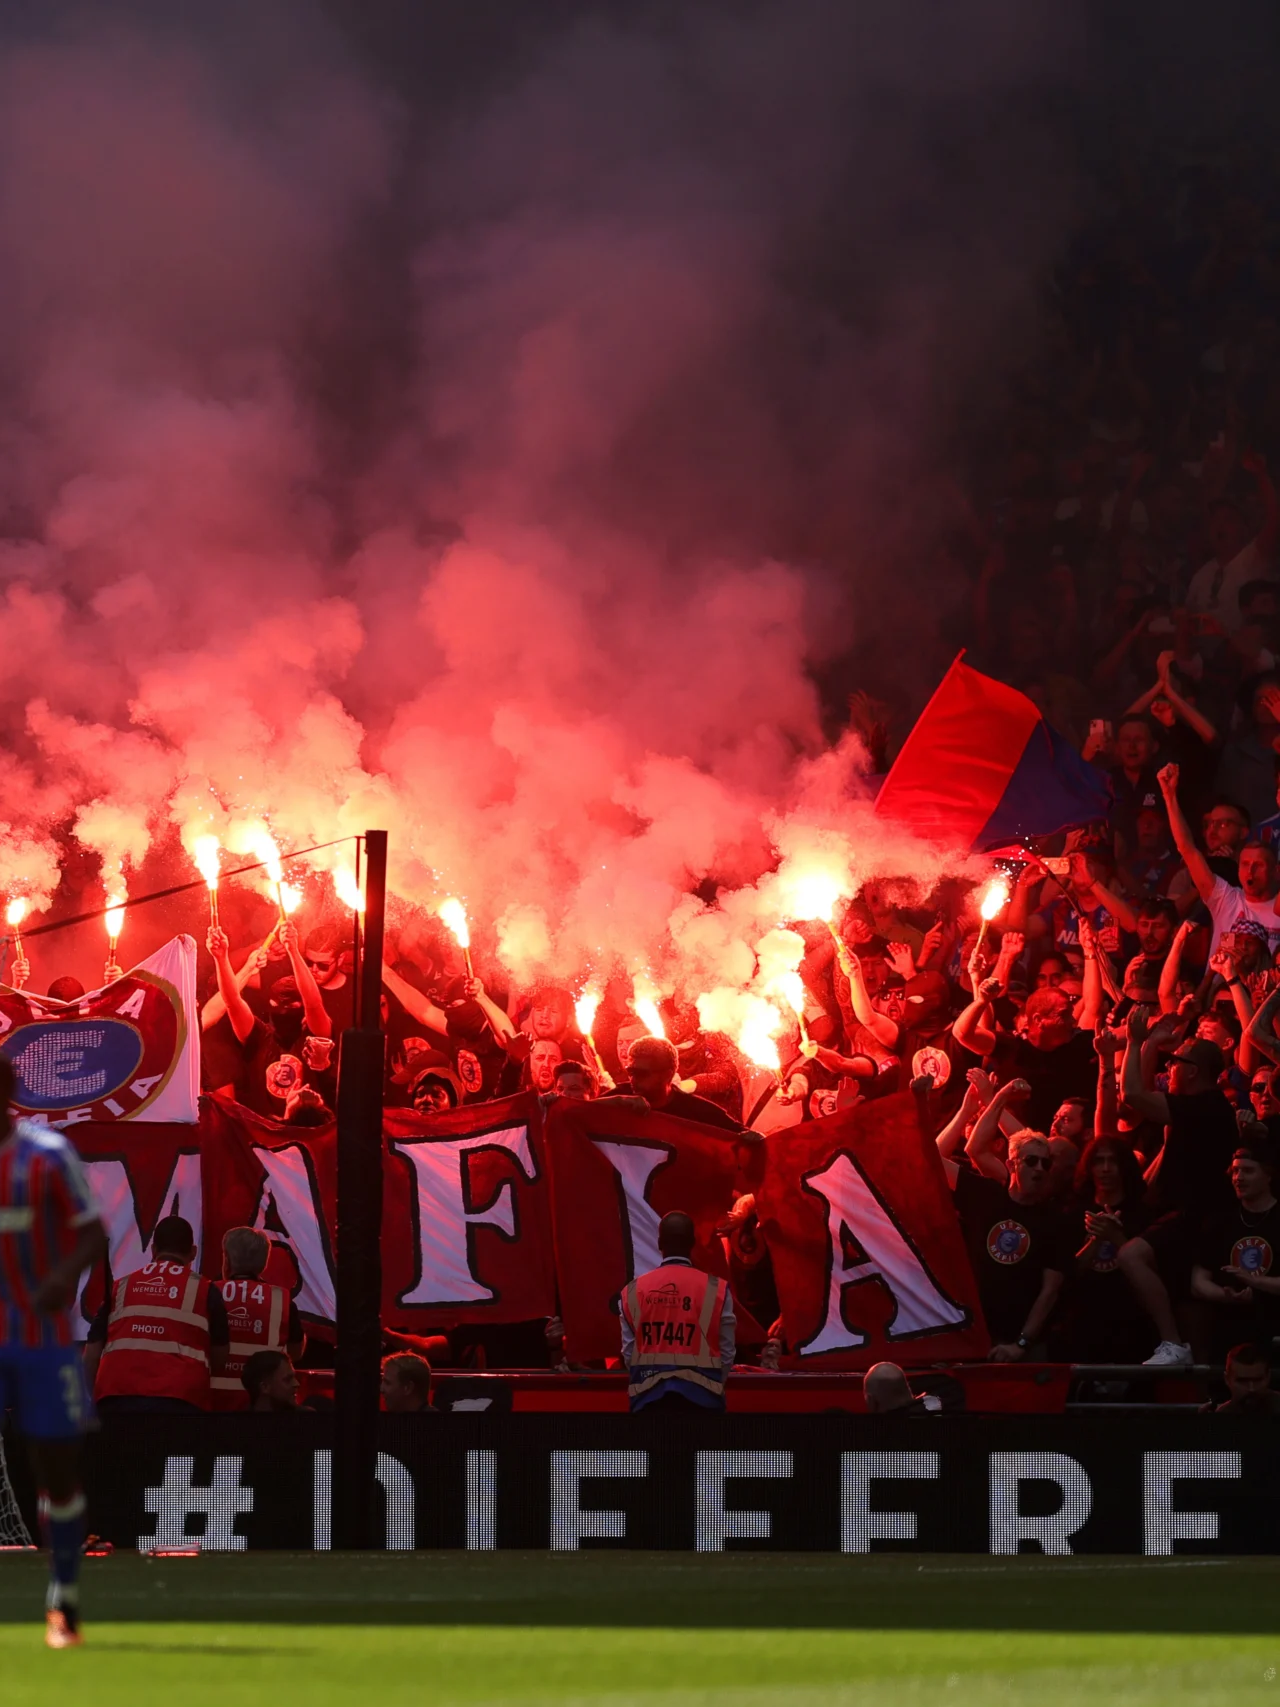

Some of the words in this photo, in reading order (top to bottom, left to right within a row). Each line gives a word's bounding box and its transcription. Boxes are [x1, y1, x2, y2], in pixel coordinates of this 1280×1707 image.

[7, 1073, 164, 1125] AFIA
[222, 1280, 265, 1304] 014
[645, 1297, 682, 1306] WEMBLEY
[131, 1323, 165, 1335] PHOTO
[228, 1319, 252, 1328] MBLEY
[641, 1321, 696, 1347] RT447
